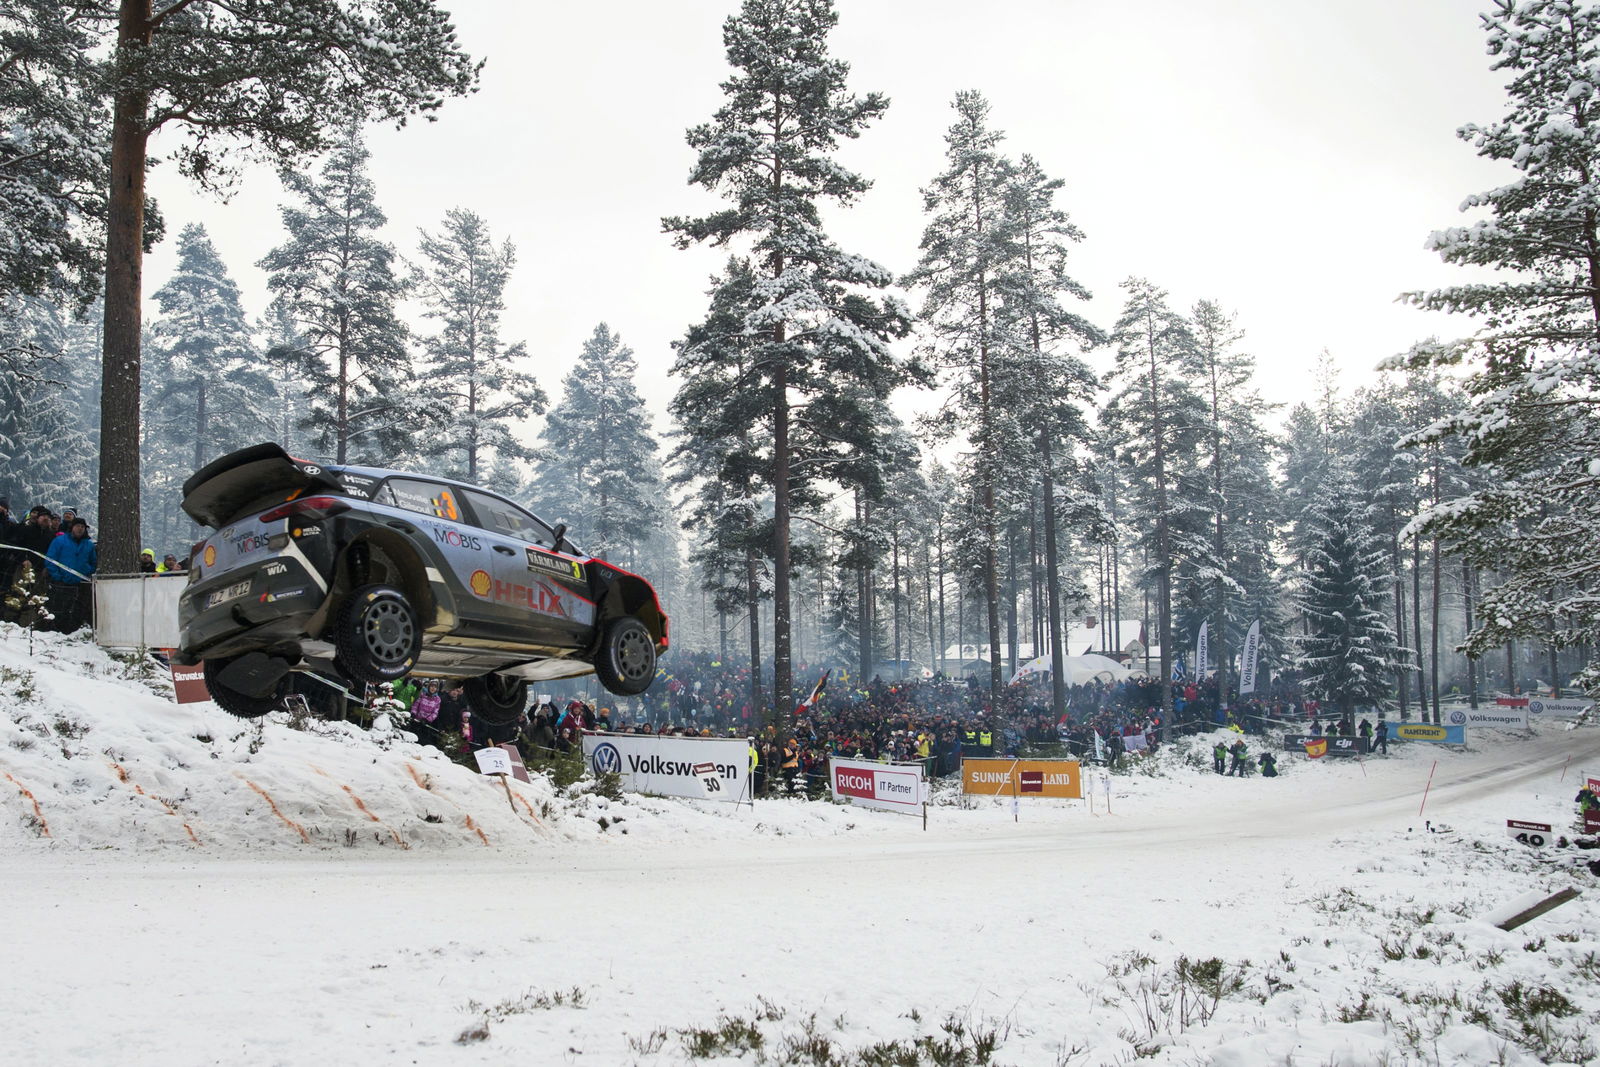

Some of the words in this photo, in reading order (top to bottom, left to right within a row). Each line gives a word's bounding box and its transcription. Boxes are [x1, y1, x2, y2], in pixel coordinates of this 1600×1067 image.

[441, 491, 458, 520] 3
[237, 532, 271, 555] MOBIS
[433, 528, 482, 551] MOBIS
[528, 551, 571, 574] VÄRMLAND
[571, 561, 581, 579] 3
[495, 579, 564, 617] HELIX
[1199, 634, 1207, 680] olkswagen
[1243, 634, 1257, 687] Volkswagen
[1546, 704, 1585, 712] Volkswage
[1469, 714, 1521, 724] Volkswagen
[1404, 728, 1441, 737] RAMIRENT
[627, 754, 737, 780] Volkswen
[703, 777, 721, 792] 30
[837, 774, 872, 792] RICOH
[971, 771, 1011, 784] SUNNE
[879, 780, 886, 791] IT
[887, 781, 912, 794] Partner
[1589, 783, 1600, 792] RI
[1515, 832, 1545, 847] 40
